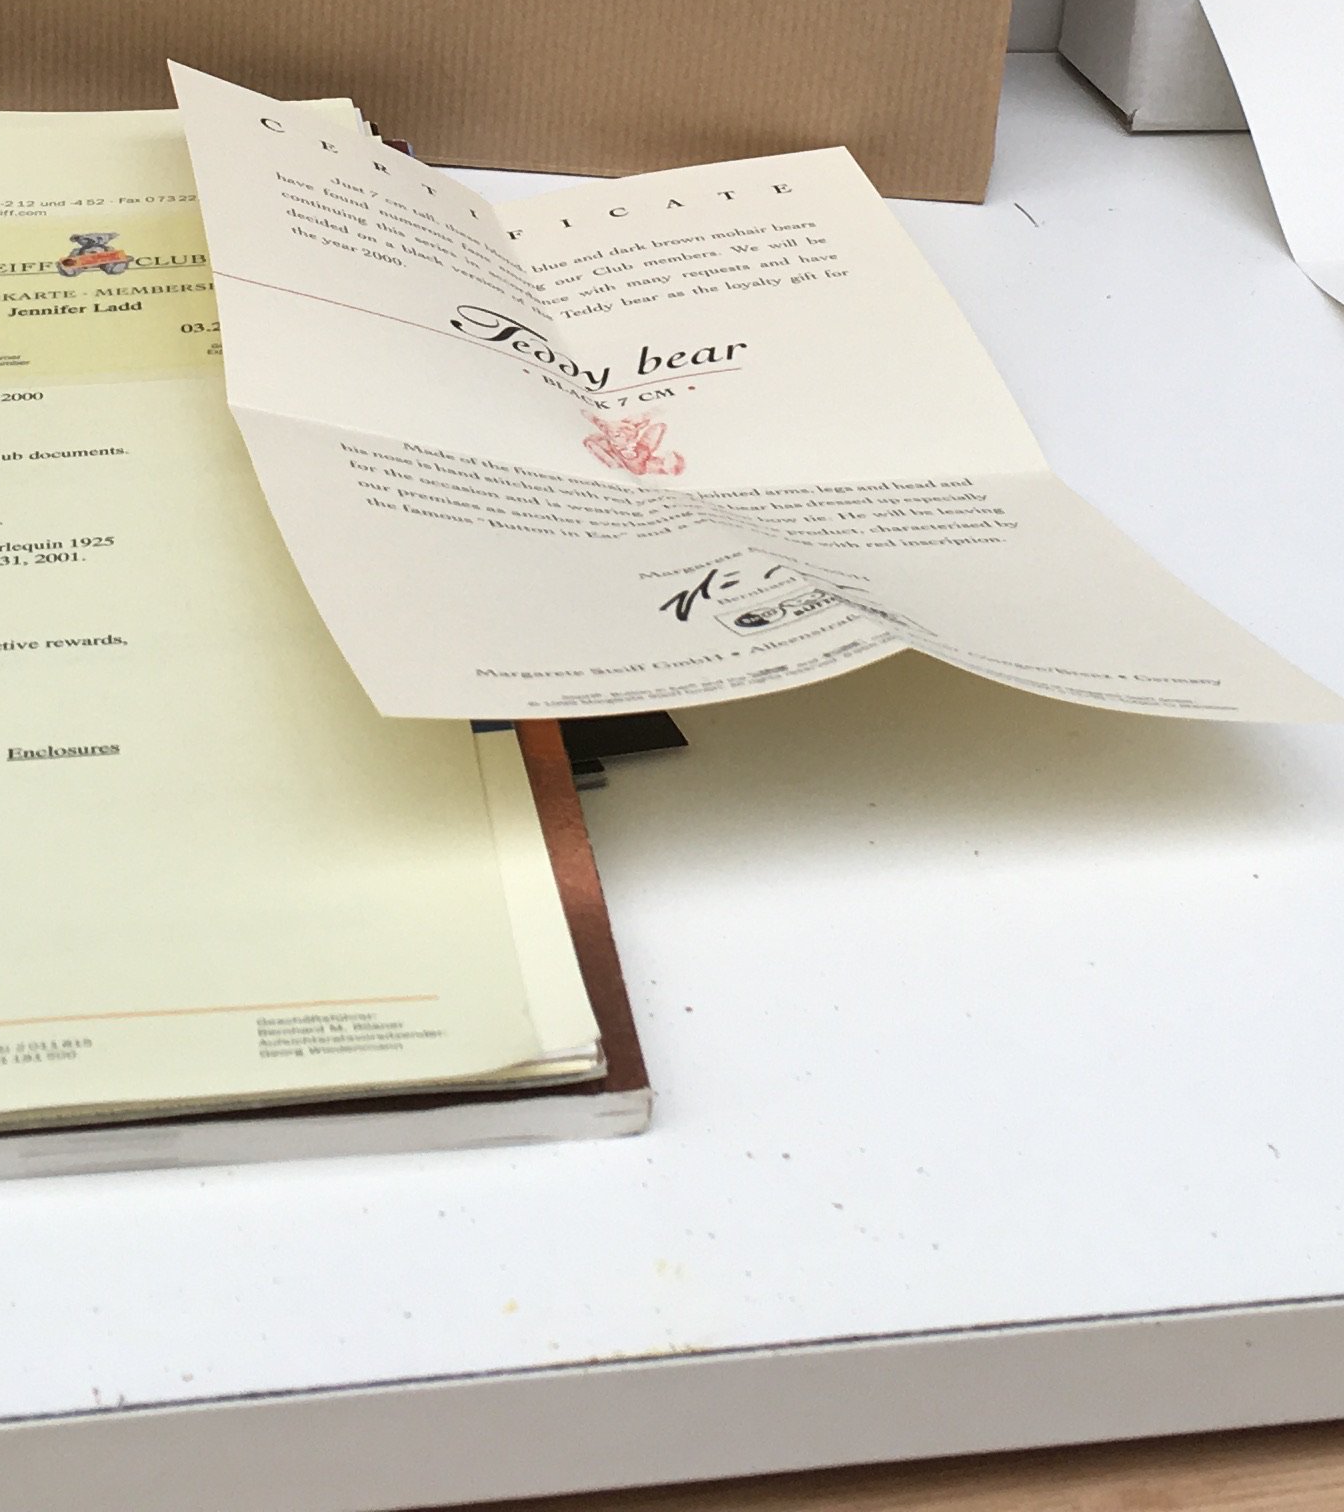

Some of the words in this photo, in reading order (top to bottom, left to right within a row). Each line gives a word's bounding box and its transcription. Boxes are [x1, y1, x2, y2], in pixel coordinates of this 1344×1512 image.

[530, 260, 567, 273] blue
[572, 249, 604, 264] and
[608, 242, 647, 256] dark
[650, 235, 705, 248] brown
[710, 225, 767, 239] mohair
[770, 221, 816, 232] bears
[134, 254, 207, 267] CLUB
[554, 273, 583, 286] our
[591, 261, 634, 276] Club
[642, 250, 721, 267] members.
[728, 243, 758, 253] We
[767, 237, 798, 249] will
[804, 236, 826, 245] be
[578, 282, 616, 297] with
[625, 274, 671, 288] many
[681, 263, 751, 278] requests
[759, 256, 790, 268] and
[797, 253, 837, 263] have
[559, 301, 613, 319] Teddy
[619, 293, 659, 306] bear
[666, 290, 685, 298] as
[691, 284, 719, 295] the
[724, 276, 781, 291] loyalty
[789, 271, 817, 284] gift
[823, 268, 848, 278] for
[7, 304, 87, 317] Jennifer
[93, 300, 142, 313] Ladd
[449, 304, 611, 393] Teddy
[636, 341, 748, 376] bear
[0, 391, 44, 402] 2000
[617, 396, 629, 408] 7
[638, 387, 676, 403] CM
[28, 446, 128, 460] documents.
[6, 744, 120, 762] Enclosures
